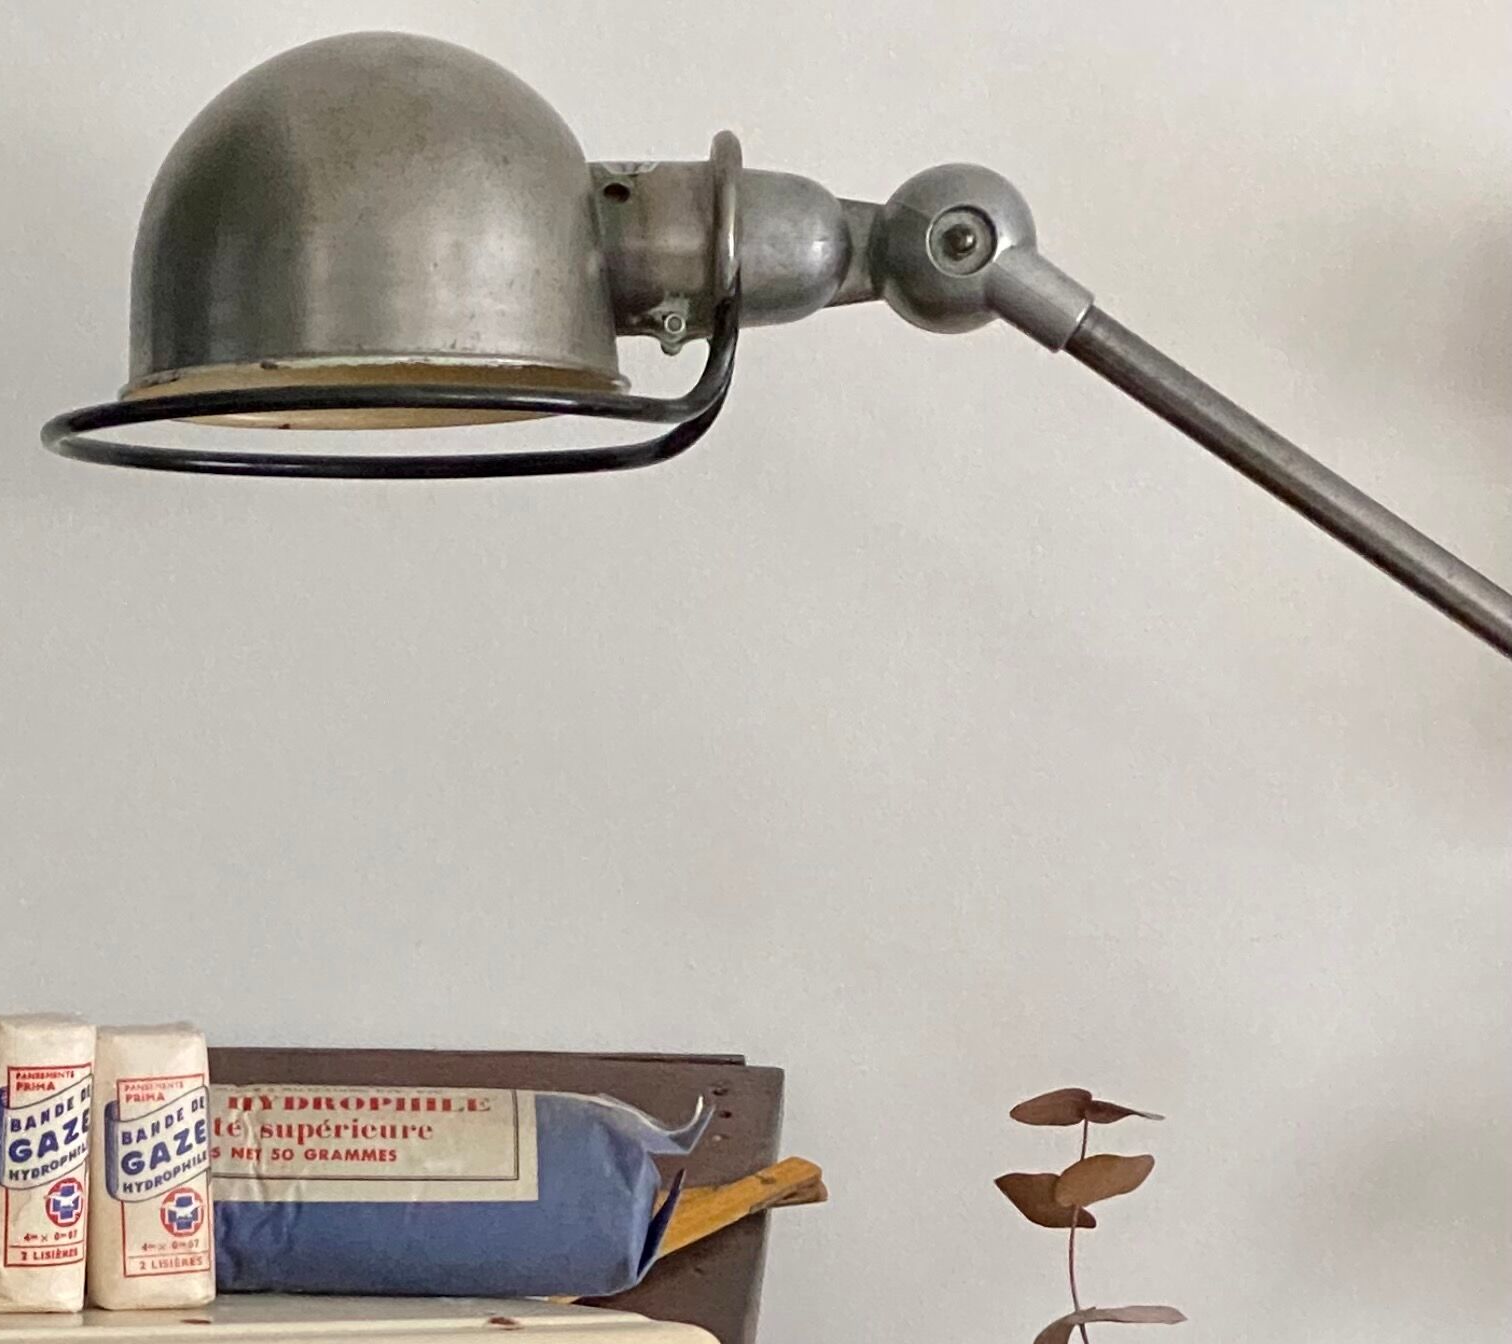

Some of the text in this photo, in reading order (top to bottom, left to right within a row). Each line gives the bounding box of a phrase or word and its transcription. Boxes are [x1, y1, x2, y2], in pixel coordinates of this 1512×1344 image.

[15, 1081, 55, 1091] PRIMA
[125, 1093, 165, 1103] PRIMA
[10, 1096, 74, 1133] BANDE
[121, 1095, 205, 1145] BANDE DE
[260, 1118, 433, 1145] supérieure
[8, 1107, 90, 1163] GAZE
[121, 1119, 207, 1176] GAZE
[9, 1144, 88, 1181] HYDROPHIL
[122, 1150, 207, 1194] HYDROPHILE
[231, 1148, 262, 1161] NET
[271, 1149, 295, 1161] 50
[304, 1149, 397, 1162] GRAMMES
[138, 1256, 203, 1270] 2 LISIÈRES
